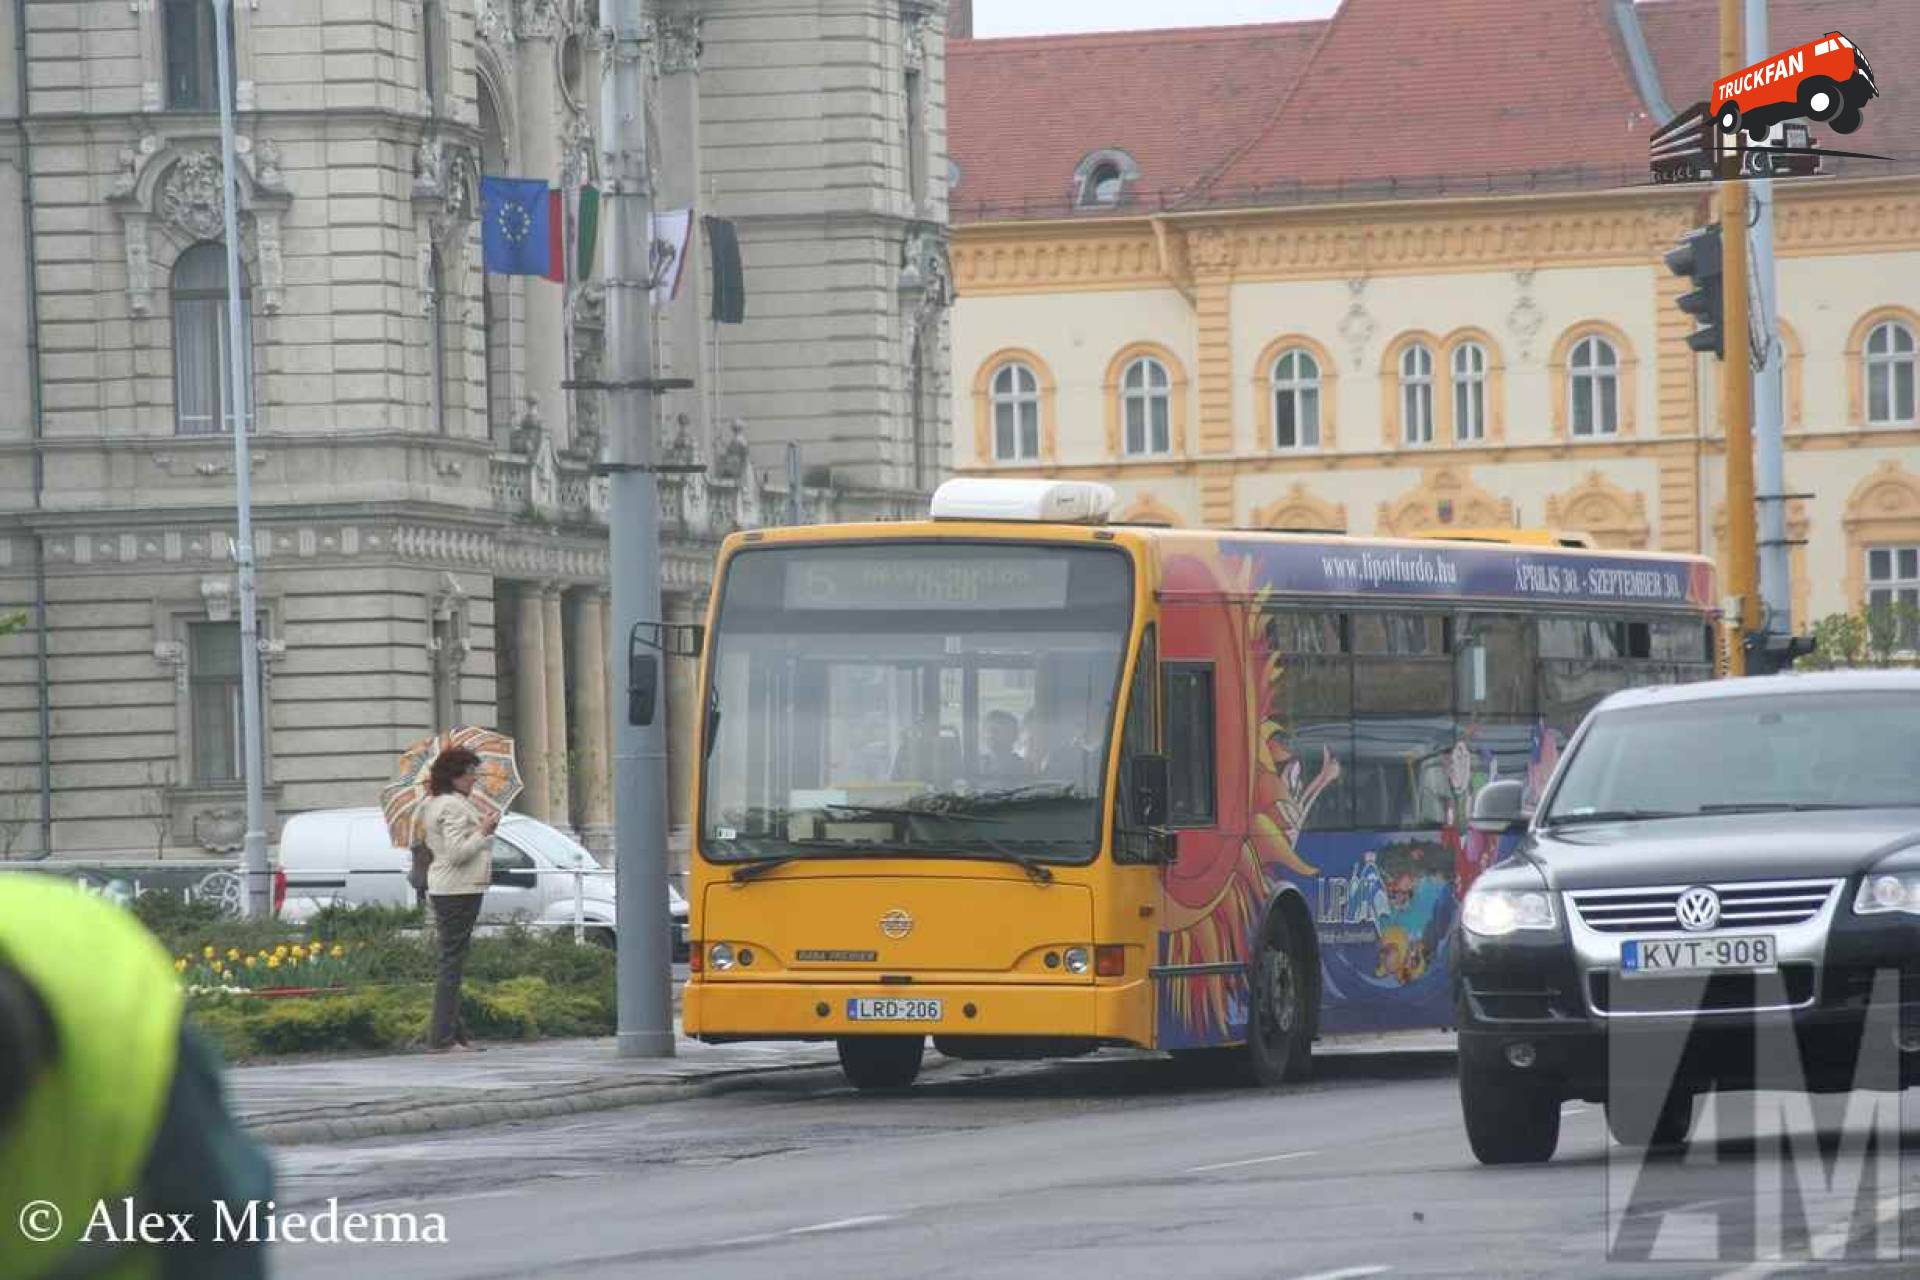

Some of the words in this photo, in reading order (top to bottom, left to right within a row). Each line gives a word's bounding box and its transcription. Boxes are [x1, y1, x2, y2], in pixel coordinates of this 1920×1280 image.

[1588, 567, 1662, 597] SZEPTEMBER
[1643, 940, 1767, 969] KVT-908
[861, 1001, 938, 1017] LRD-206
